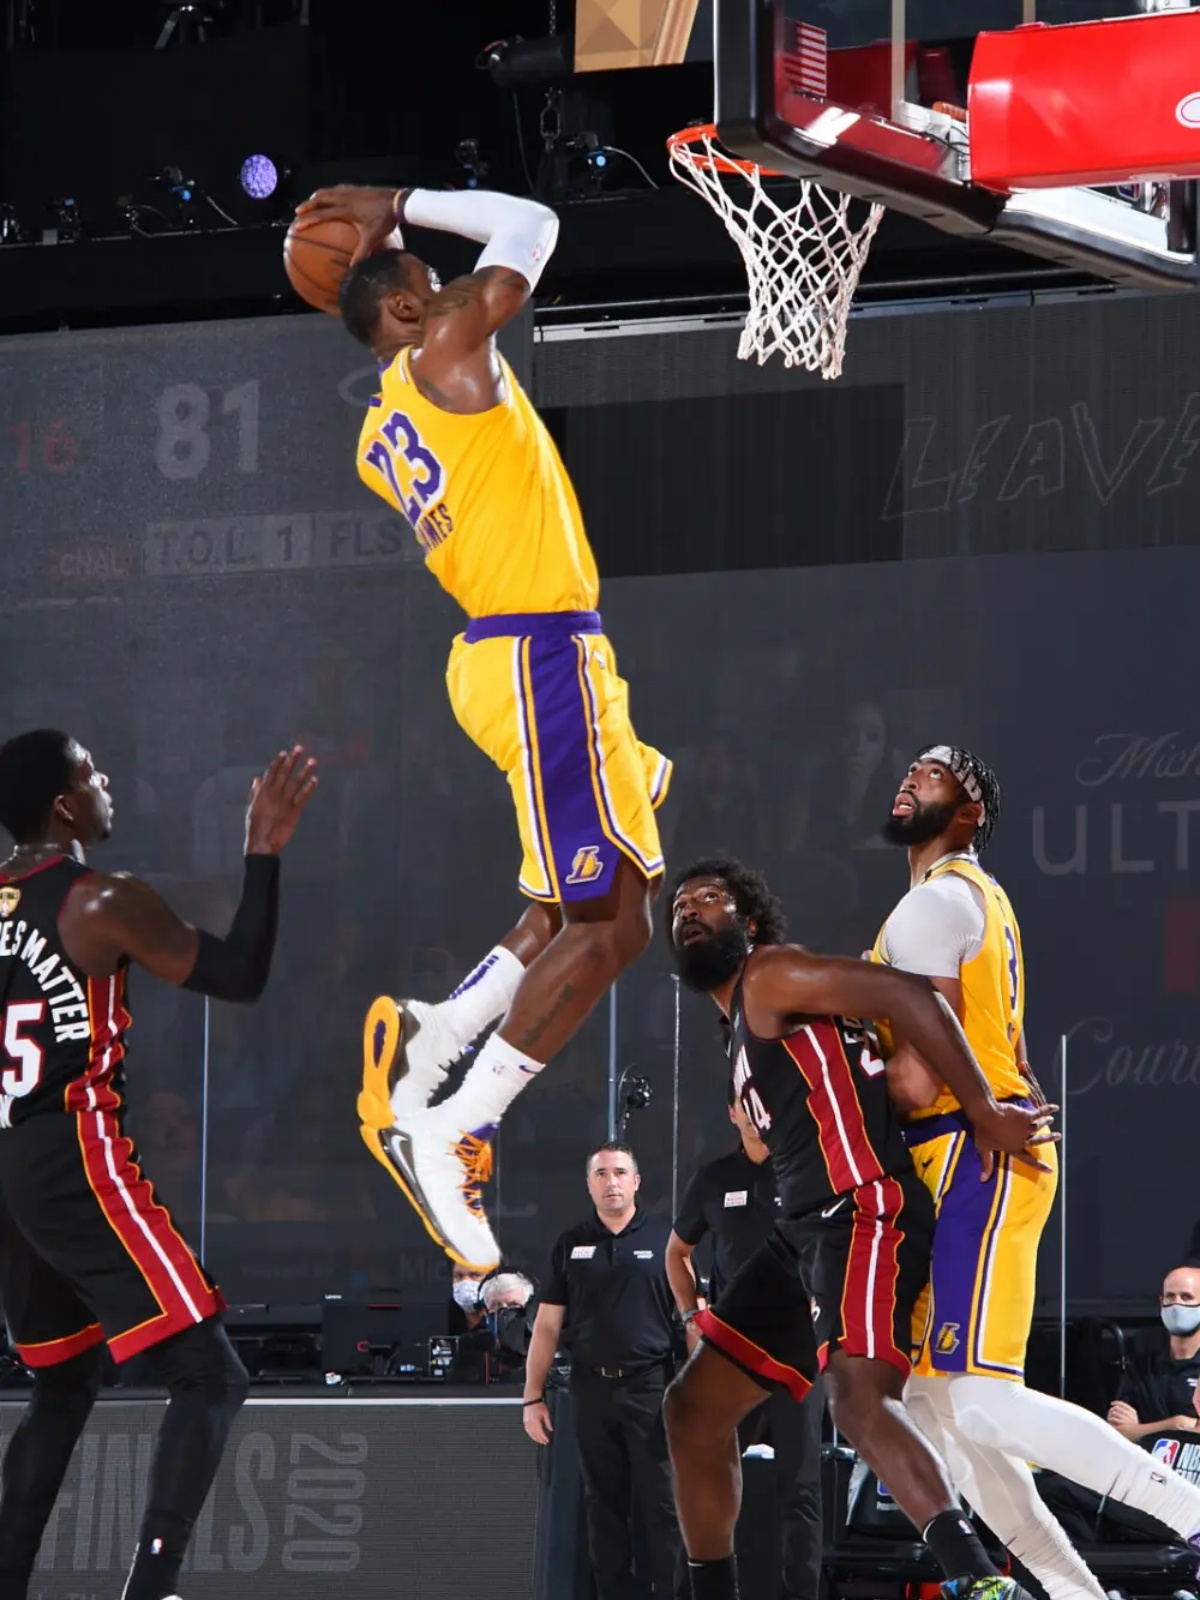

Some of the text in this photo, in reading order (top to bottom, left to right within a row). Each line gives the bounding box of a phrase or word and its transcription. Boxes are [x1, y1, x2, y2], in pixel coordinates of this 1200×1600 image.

[155, 380, 260, 480] 81
[364, 408, 448, 530] 23
[277, 524, 293, 561] 1
[329, 517, 403, 559] FLS
[1032, 801, 1200, 877] ULT
[281, 1432, 369, 1572] 2020
